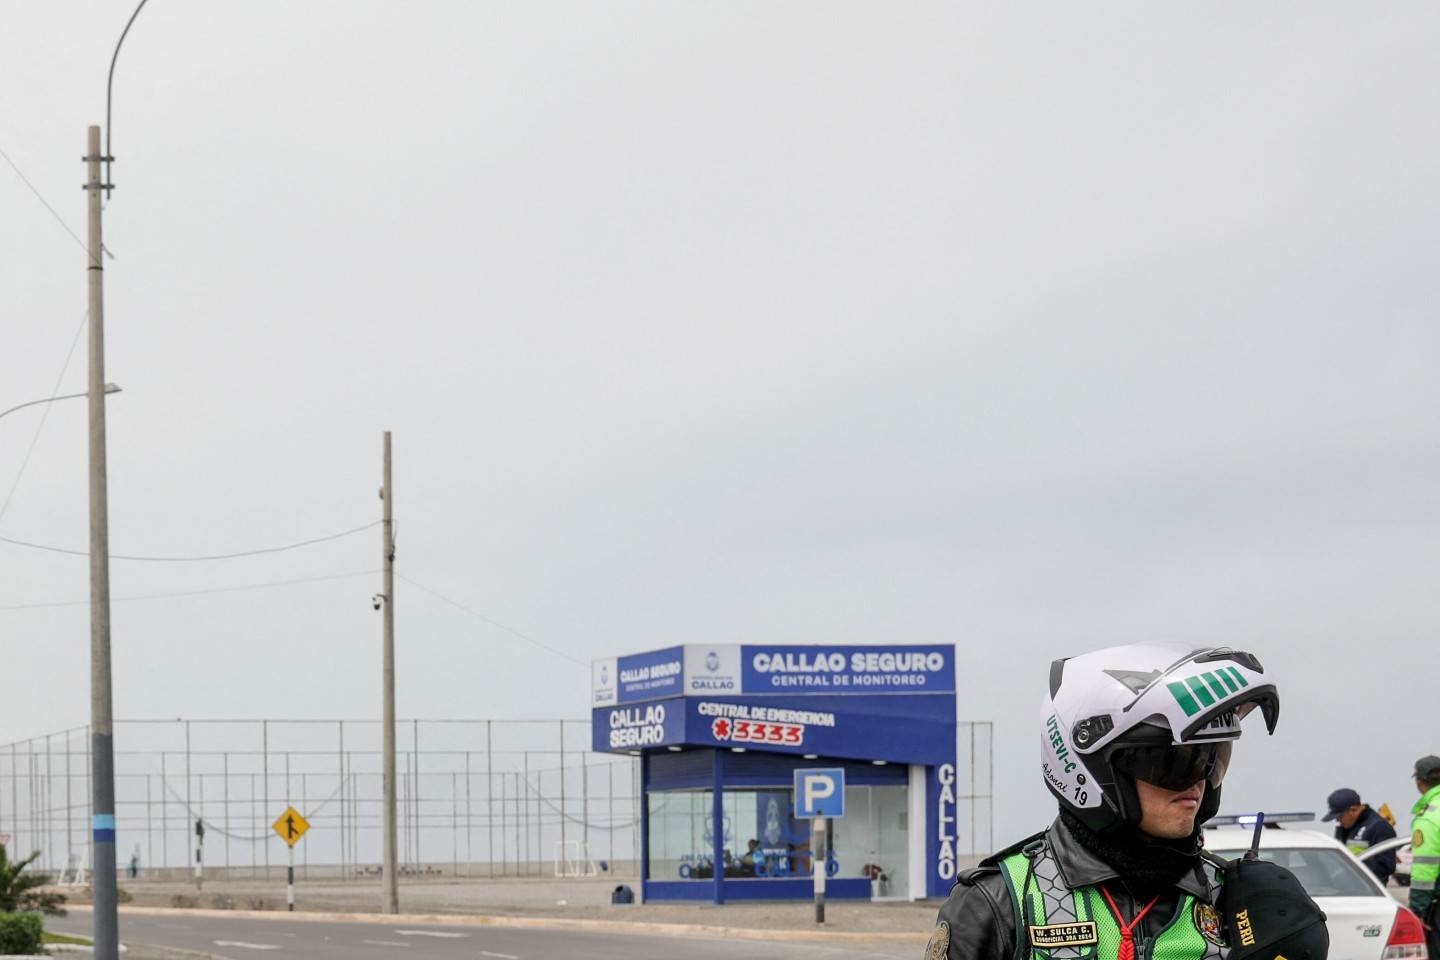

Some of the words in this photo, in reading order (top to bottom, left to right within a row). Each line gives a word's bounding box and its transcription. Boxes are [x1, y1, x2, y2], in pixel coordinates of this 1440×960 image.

[620, 665, 650, 683] CALLAO
[651, 660, 681, 679] SEGURO
[753, 652, 845, 673] CALLAO
[851, 652, 944, 672] SEGURO
[691, 681, 734, 689] CALLAO
[771, 675, 829, 686] CENTRAL
[833, 675, 850, 686] DE
[853, 675, 926, 685] MONITOREO
[610, 705, 665, 729] CALLAO
[698, 702, 750, 719] CENTRAL
[751, 706, 767, 720] DE
[767, 709, 835, 727] EMERGENCIA
[610, 726, 664, 748] SEGURO
[1046, 714, 1077, 774] UTSEVI-C
[804, 774, 835, 813] P
[1074, 786, 1088, 806] 19
[938, 763, 955, 880] CALLAO
[1036, 929, 1047, 937] W.
[1050, 927, 1078, 936] SULCA
[1235, 909, 1255, 947] PERU
